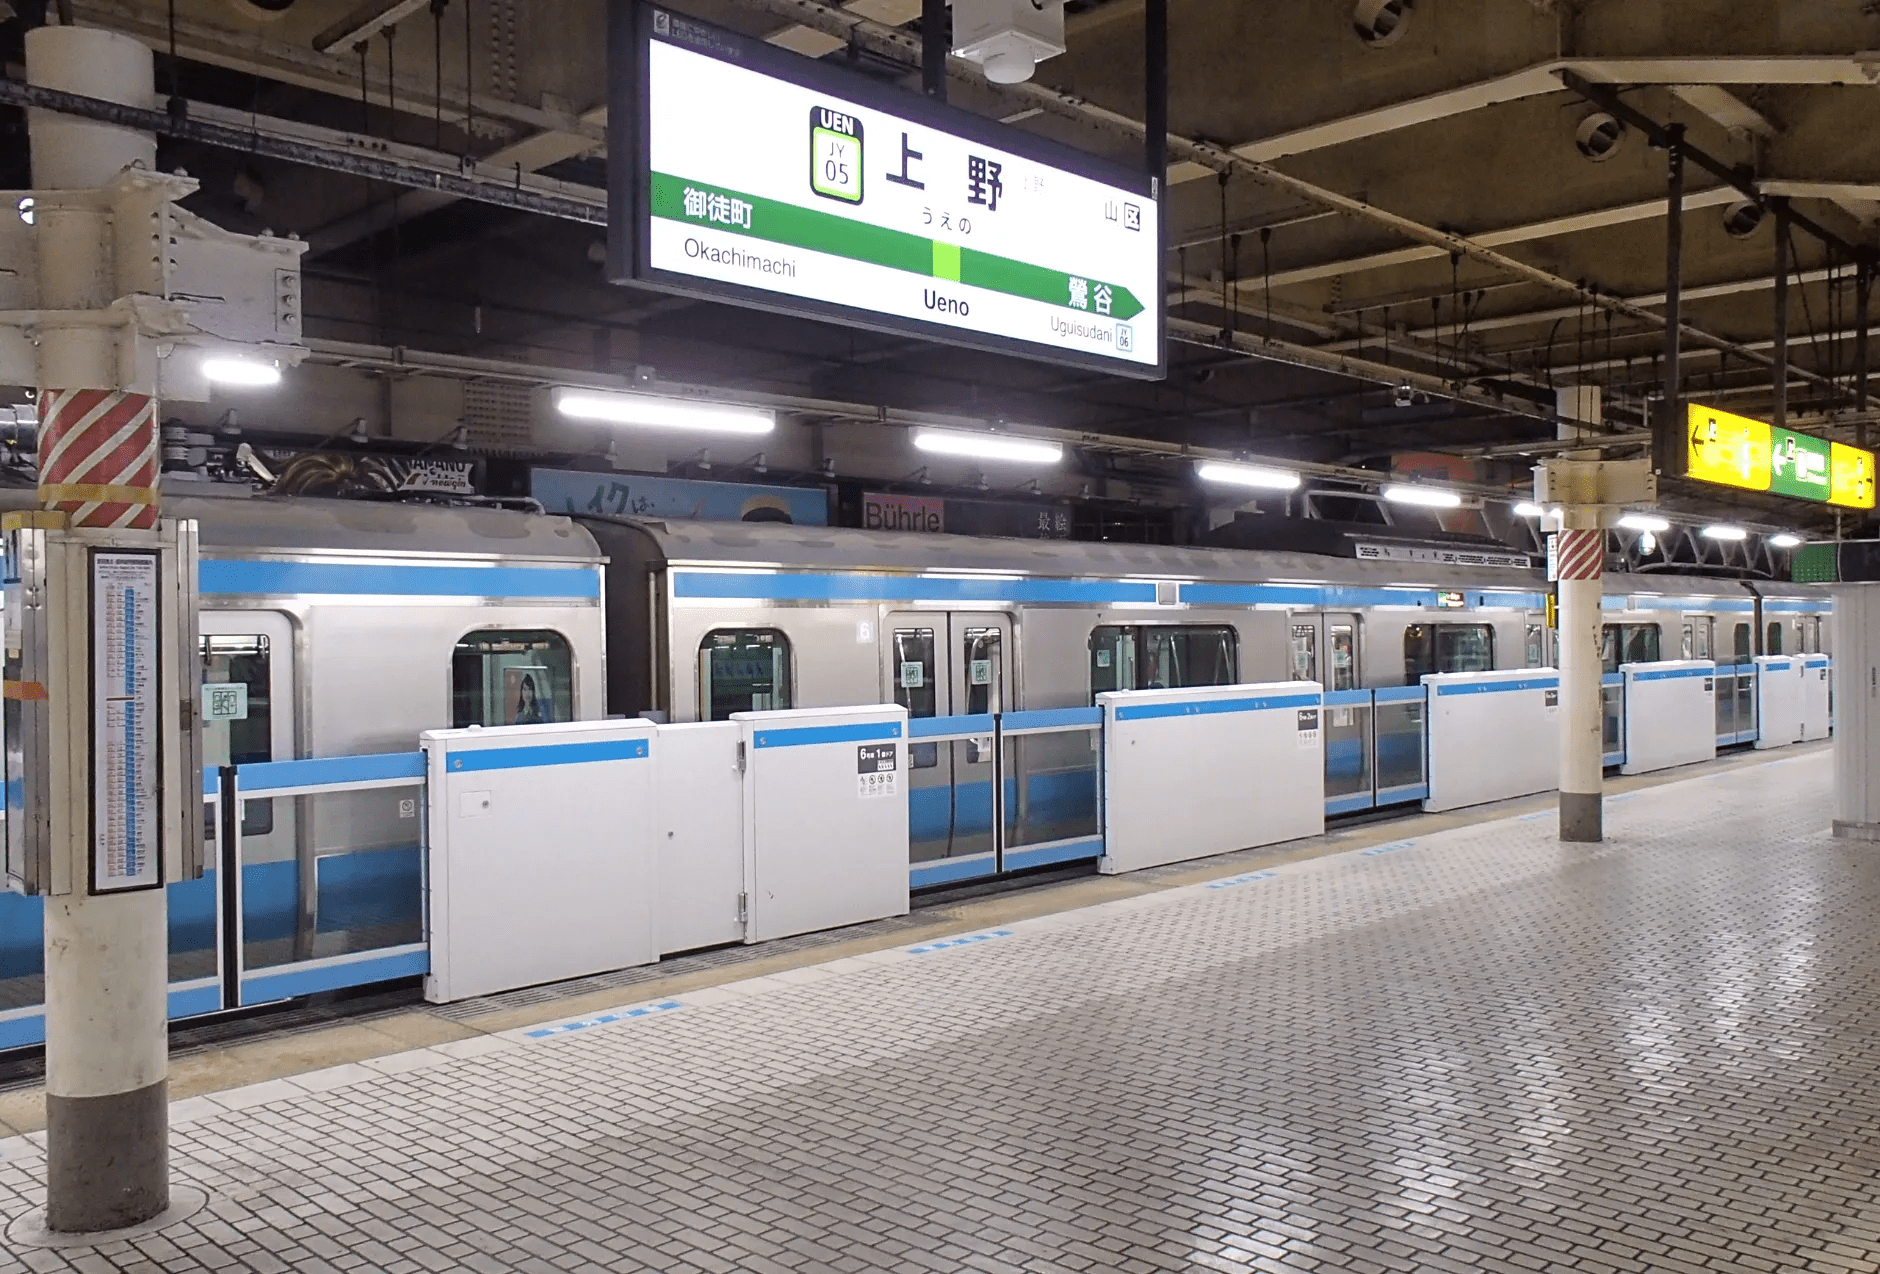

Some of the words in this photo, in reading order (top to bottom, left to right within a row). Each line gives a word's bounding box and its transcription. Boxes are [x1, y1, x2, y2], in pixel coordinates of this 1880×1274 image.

[820, 109, 854, 135] UEN
[829, 142, 845, 158] JY
[825, 159, 849, 185] 05
[885, 131, 1002, 212] 上野
[683, 186, 753, 229] 御徒町
[922, 206, 972, 235] うえの
[684, 238, 796, 278] Okachimachi
[924, 288, 970, 317] Ueno
[1050, 315, 1113, 343] Uguisudani
[1119, 337, 1129, 348] 06
[866, 502, 941, 533] Bührle
[860, 622, 870, 640] 6
